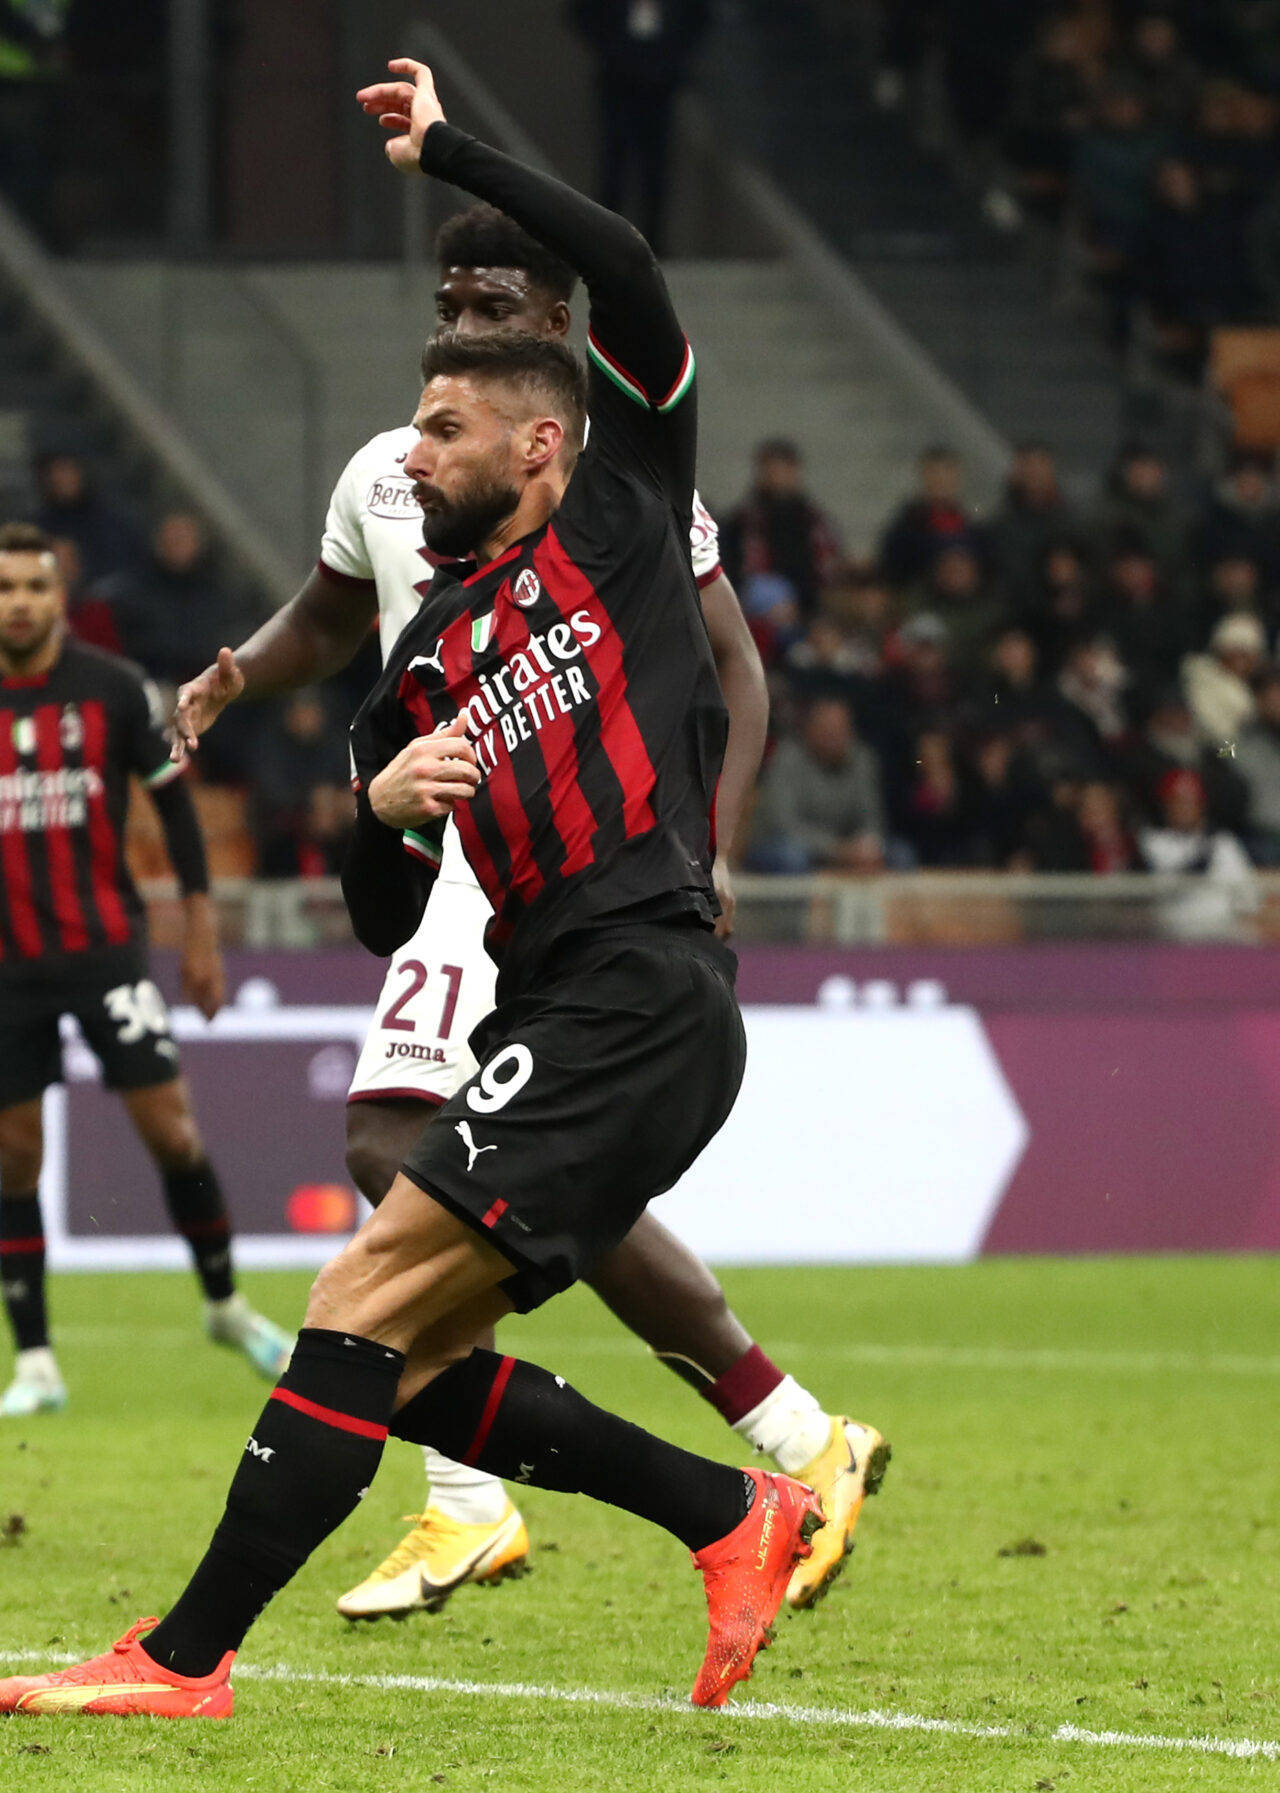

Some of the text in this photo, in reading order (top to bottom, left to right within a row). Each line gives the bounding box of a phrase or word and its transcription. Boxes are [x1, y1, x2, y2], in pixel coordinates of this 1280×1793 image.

[368, 484, 421, 508] Bere
[433, 610, 602, 744] mirates
[500, 665, 592, 753] BETTER
[380, 959, 464, 1040] 21
[466, 1043, 534, 1114] 9
[755, 1508, 775, 1571] ULTRA
